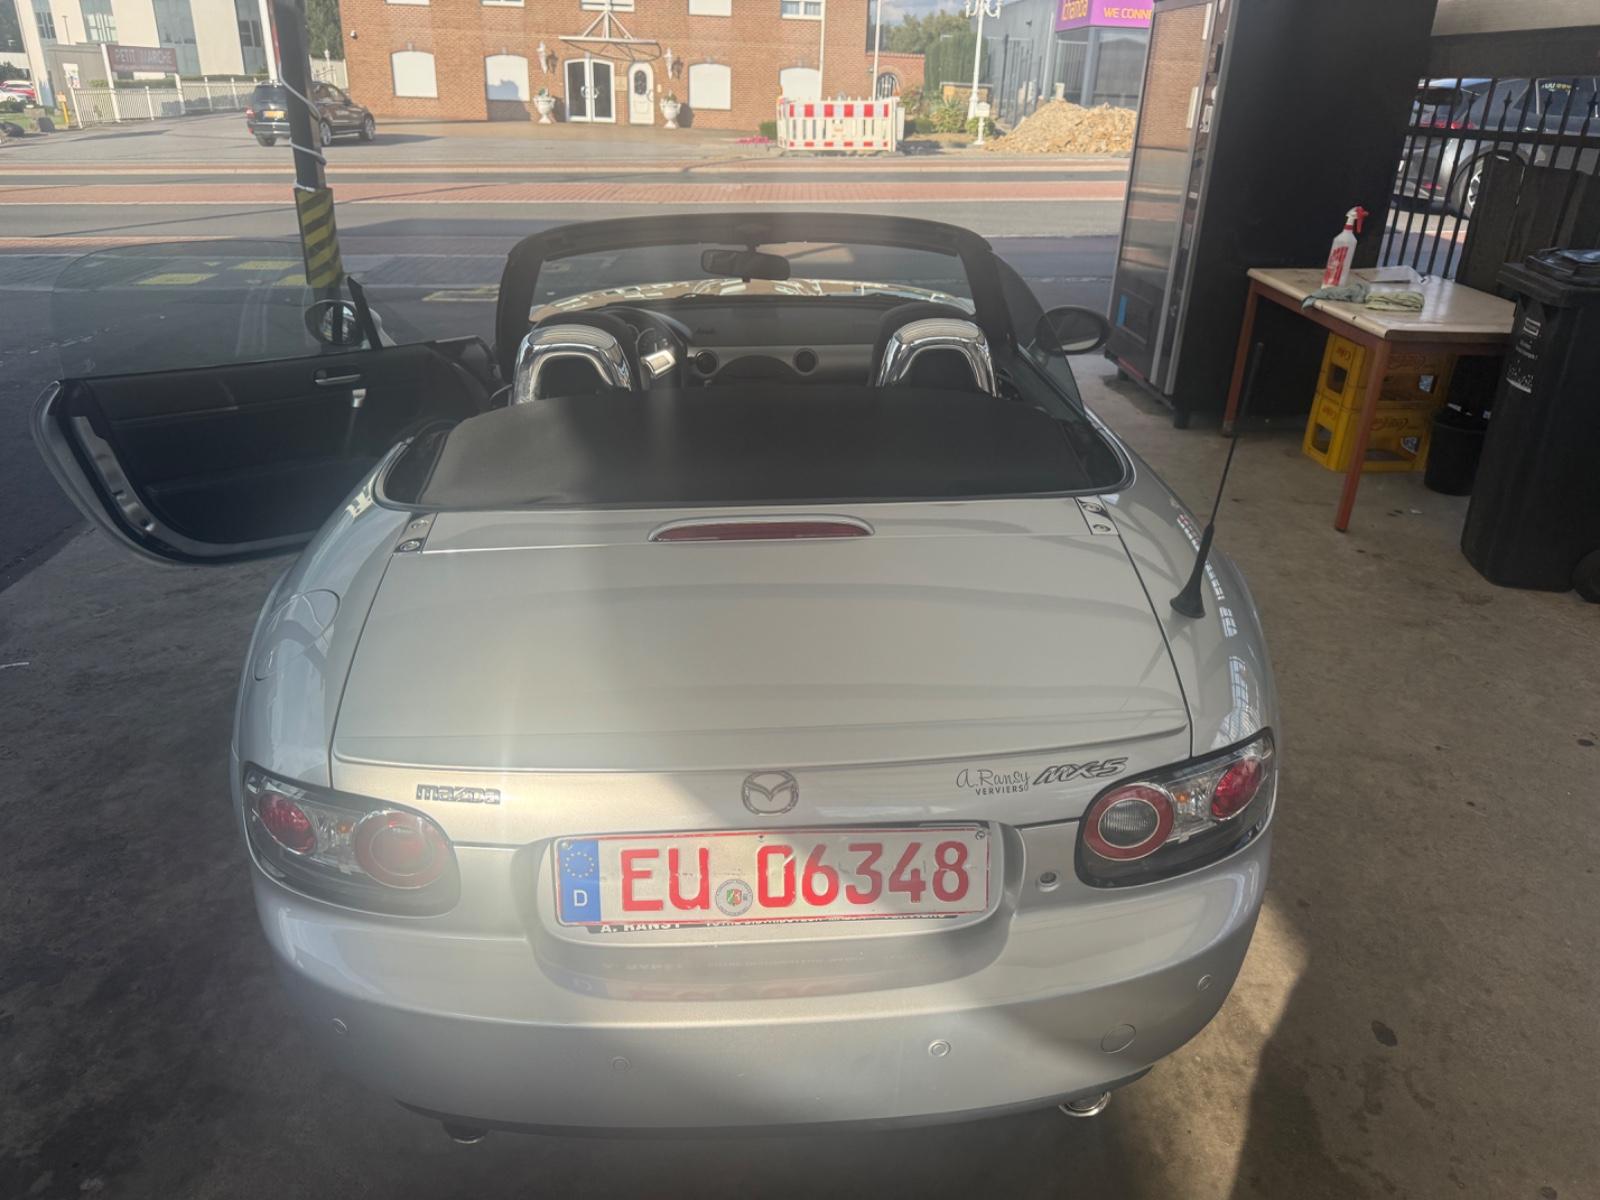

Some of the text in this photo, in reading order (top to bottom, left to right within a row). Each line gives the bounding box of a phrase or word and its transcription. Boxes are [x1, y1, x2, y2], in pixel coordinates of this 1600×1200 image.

[1103, 7, 1119, 18] WE
[416, 784, 501, 804] mazda
[975, 786, 1024, 796] VERVIERS
[621, 848, 710, 911] EU
[757, 841, 969, 908] 06348
[573, 890, 588, 907] D
